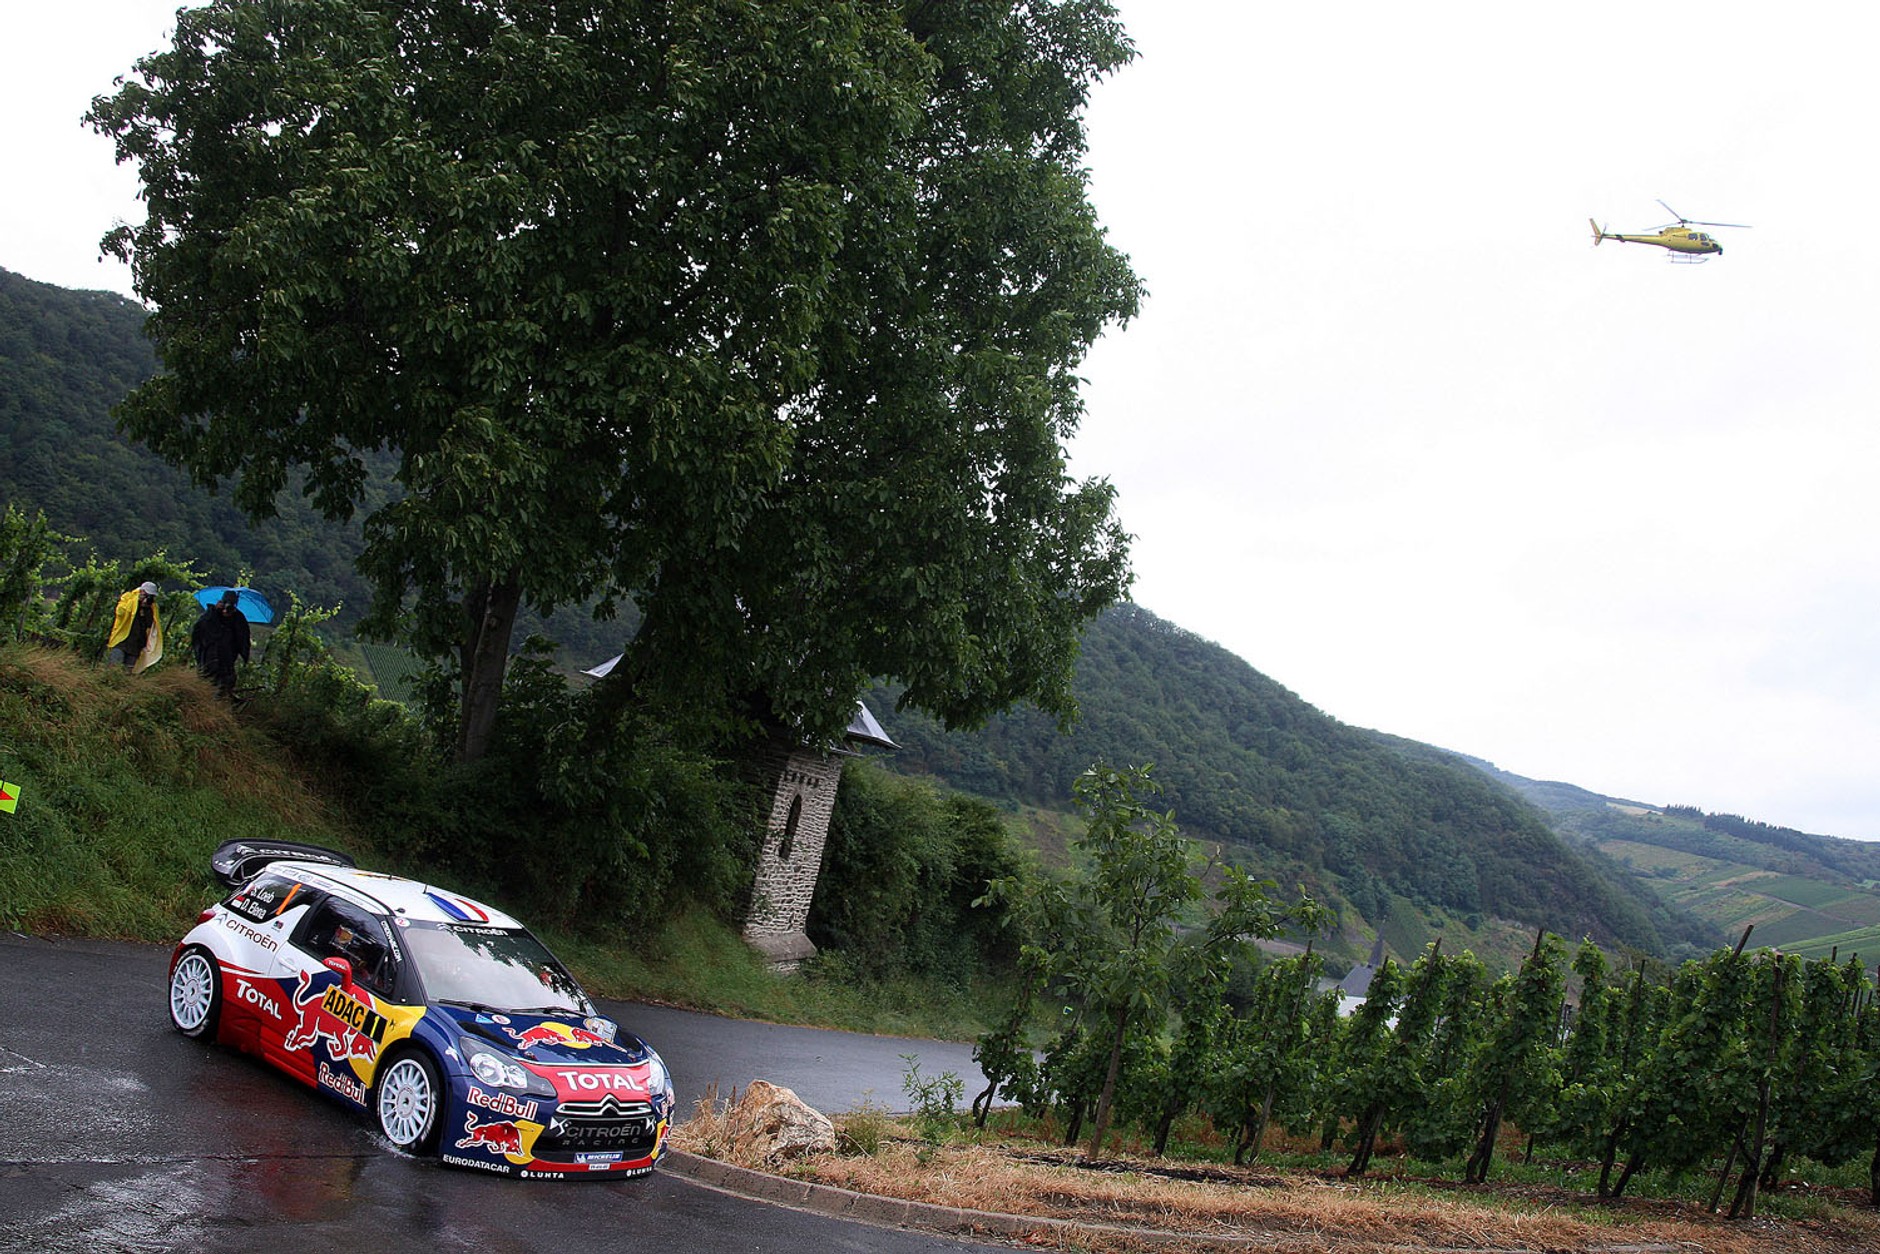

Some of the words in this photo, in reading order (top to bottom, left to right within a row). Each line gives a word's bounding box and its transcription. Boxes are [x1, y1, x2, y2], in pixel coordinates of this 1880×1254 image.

[256, 887, 275, 903] Loeb
[240, 898, 250, 911] D.
[247, 901, 267, 920] Elena
[225, 919, 278, 953] CITROËN
[236, 978, 282, 1020] TOTAL
[323, 989, 365, 1027] ADAC
[369, 1015, 380, 1038] 1
[556, 1071, 645, 1091] TOTAL
[566, 1123, 641, 1138] CITROËN
[562, 1137, 640, 1146] RACING
[442, 1154, 510, 1174] EURODATACAR
[529, 1171, 564, 1179] LUHTA
